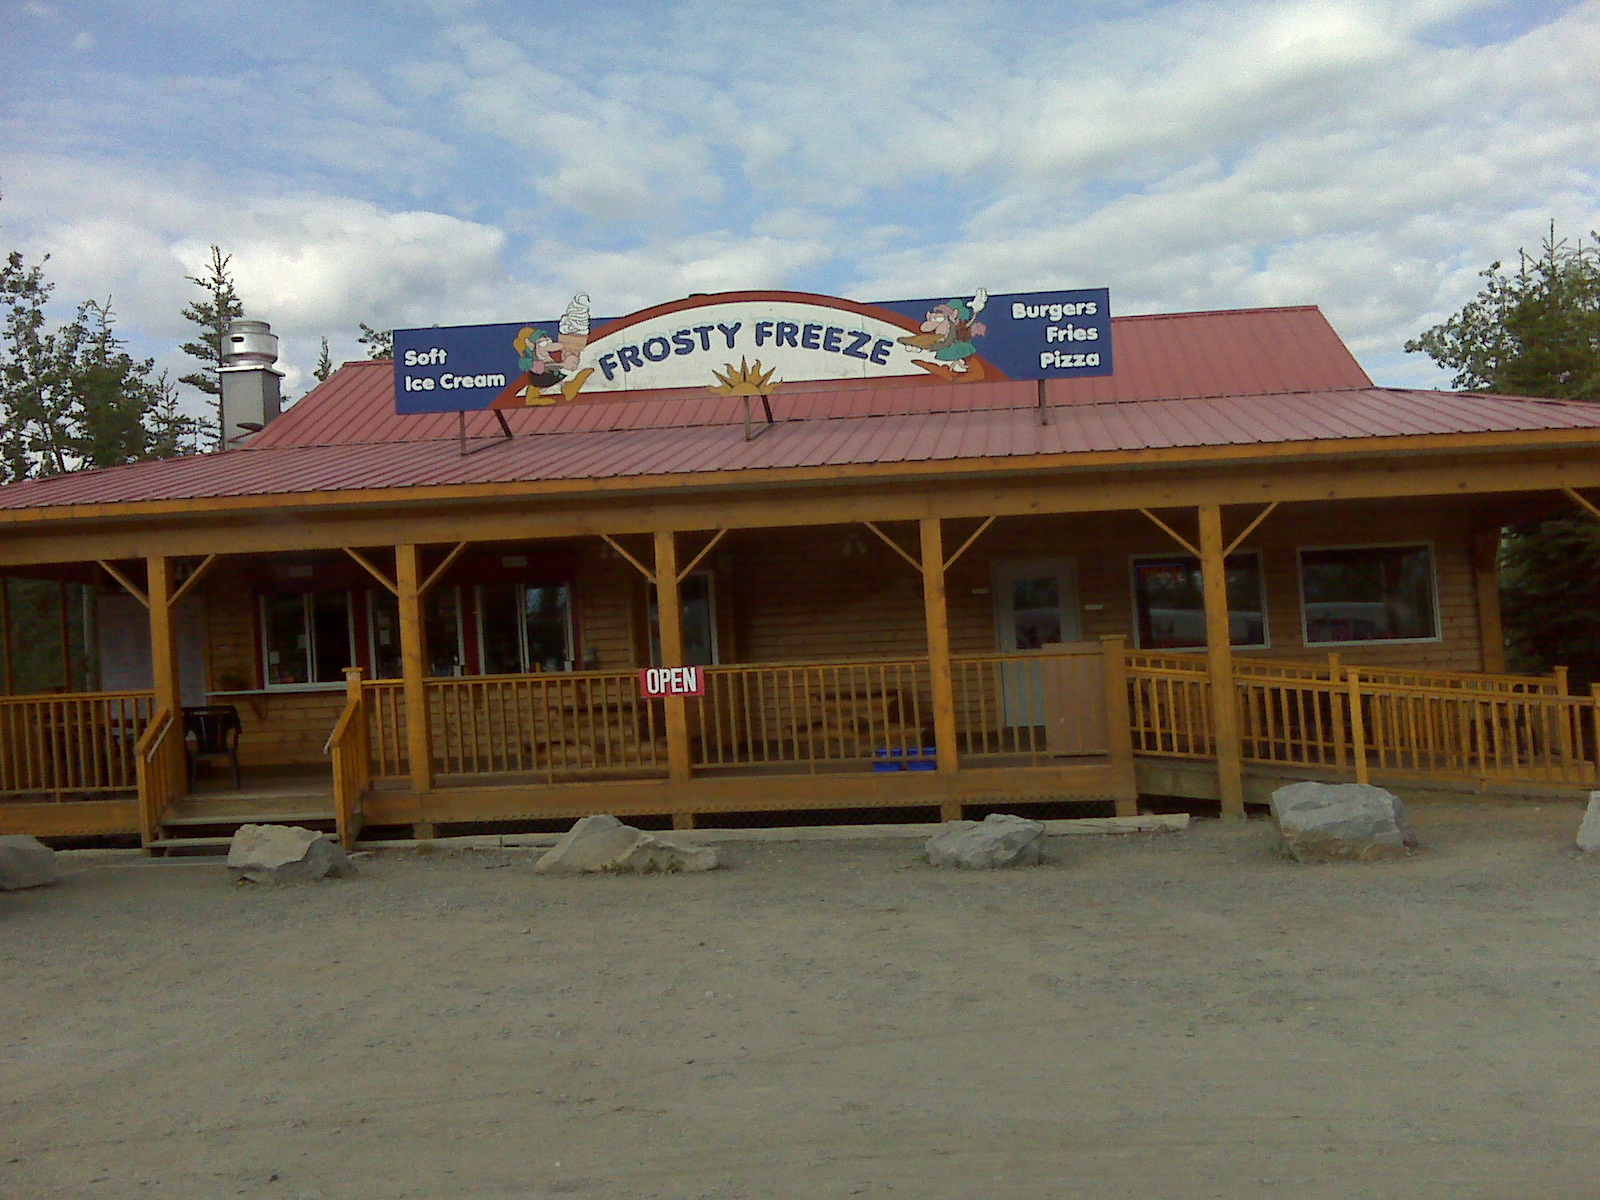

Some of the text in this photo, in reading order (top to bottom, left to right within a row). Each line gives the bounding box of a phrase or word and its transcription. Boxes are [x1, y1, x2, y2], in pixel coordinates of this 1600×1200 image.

[1011, 302, 1098, 321] Burgers
[1046, 326, 1099, 343] Fries
[403, 348, 447, 367] Soft
[599, 320, 894, 380] FROSTY FREEZE
[1040, 351, 1101, 369] Pizza
[404, 373, 506, 392] Ice Cream
[646, 667, 697, 694] OPEN
